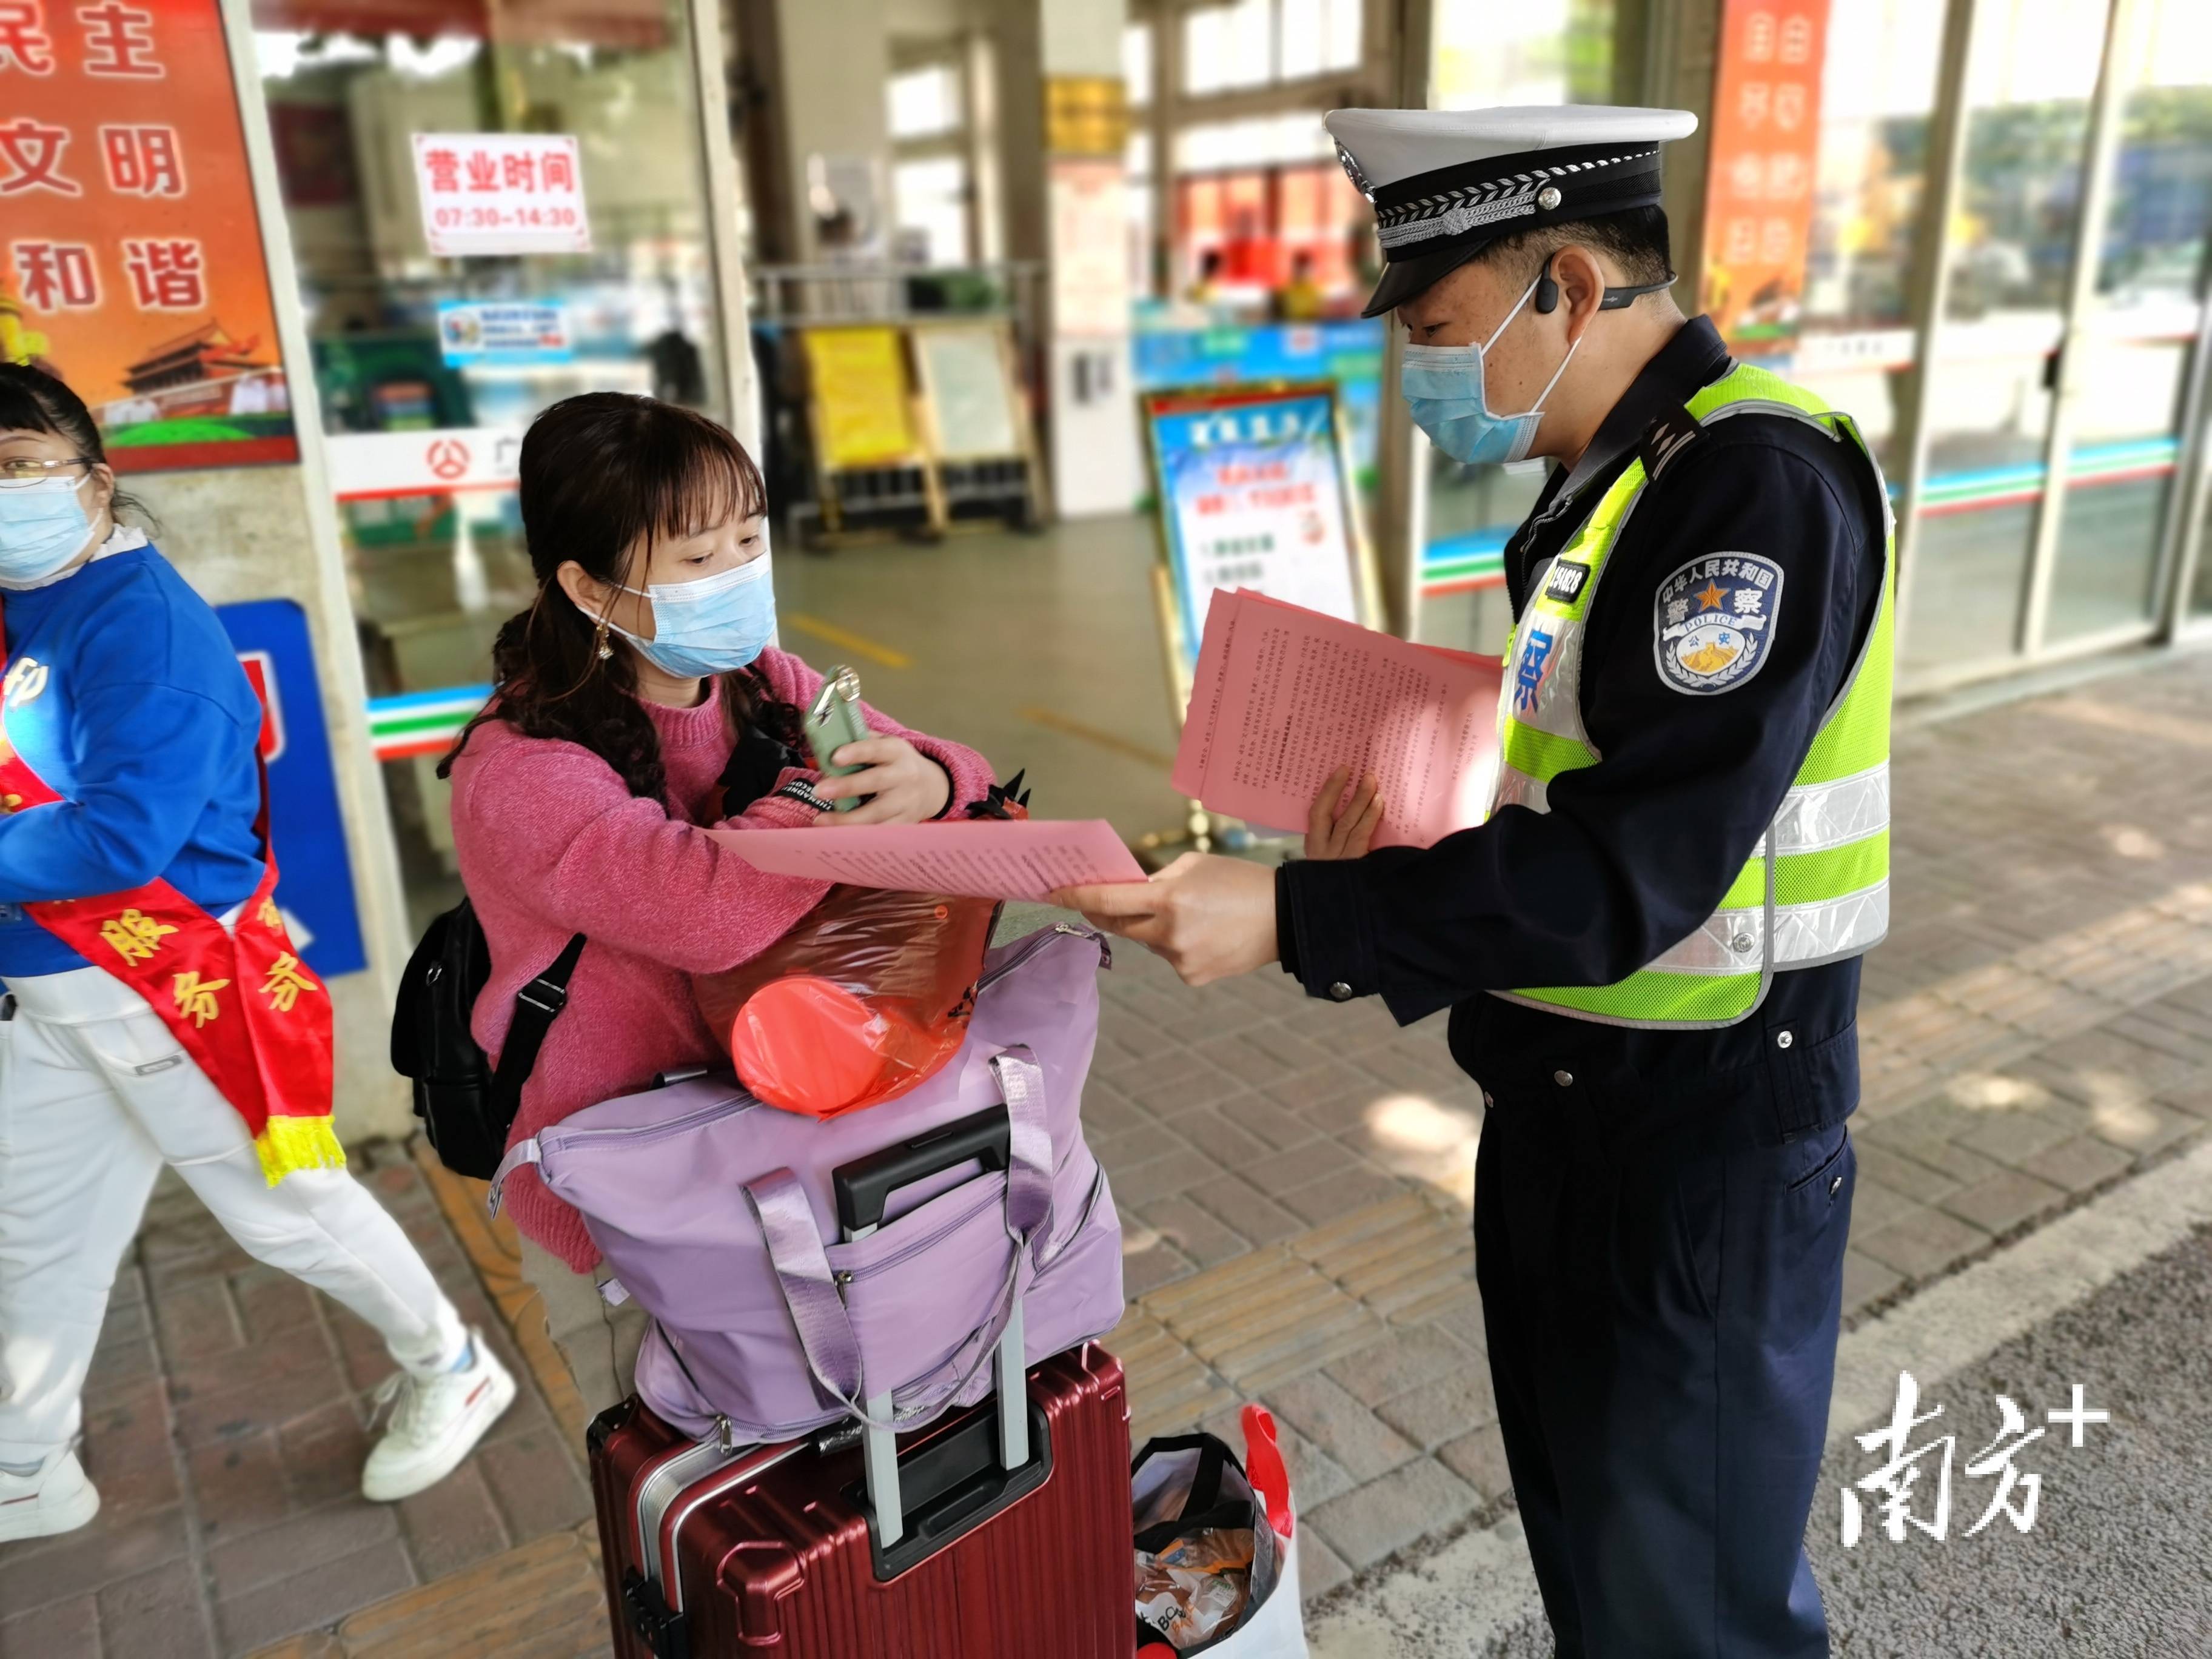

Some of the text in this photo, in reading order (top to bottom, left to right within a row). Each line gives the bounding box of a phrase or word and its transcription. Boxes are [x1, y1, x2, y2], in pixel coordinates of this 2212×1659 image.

[0, 119, 187, 198] 文明
[426, 149, 575, 194] 营业时间
[12, 239, 206, 313] 和谐
[1663, 558, 1775, 603] 中华人民共和国
[1683, 615, 1738, 632] POLICE
